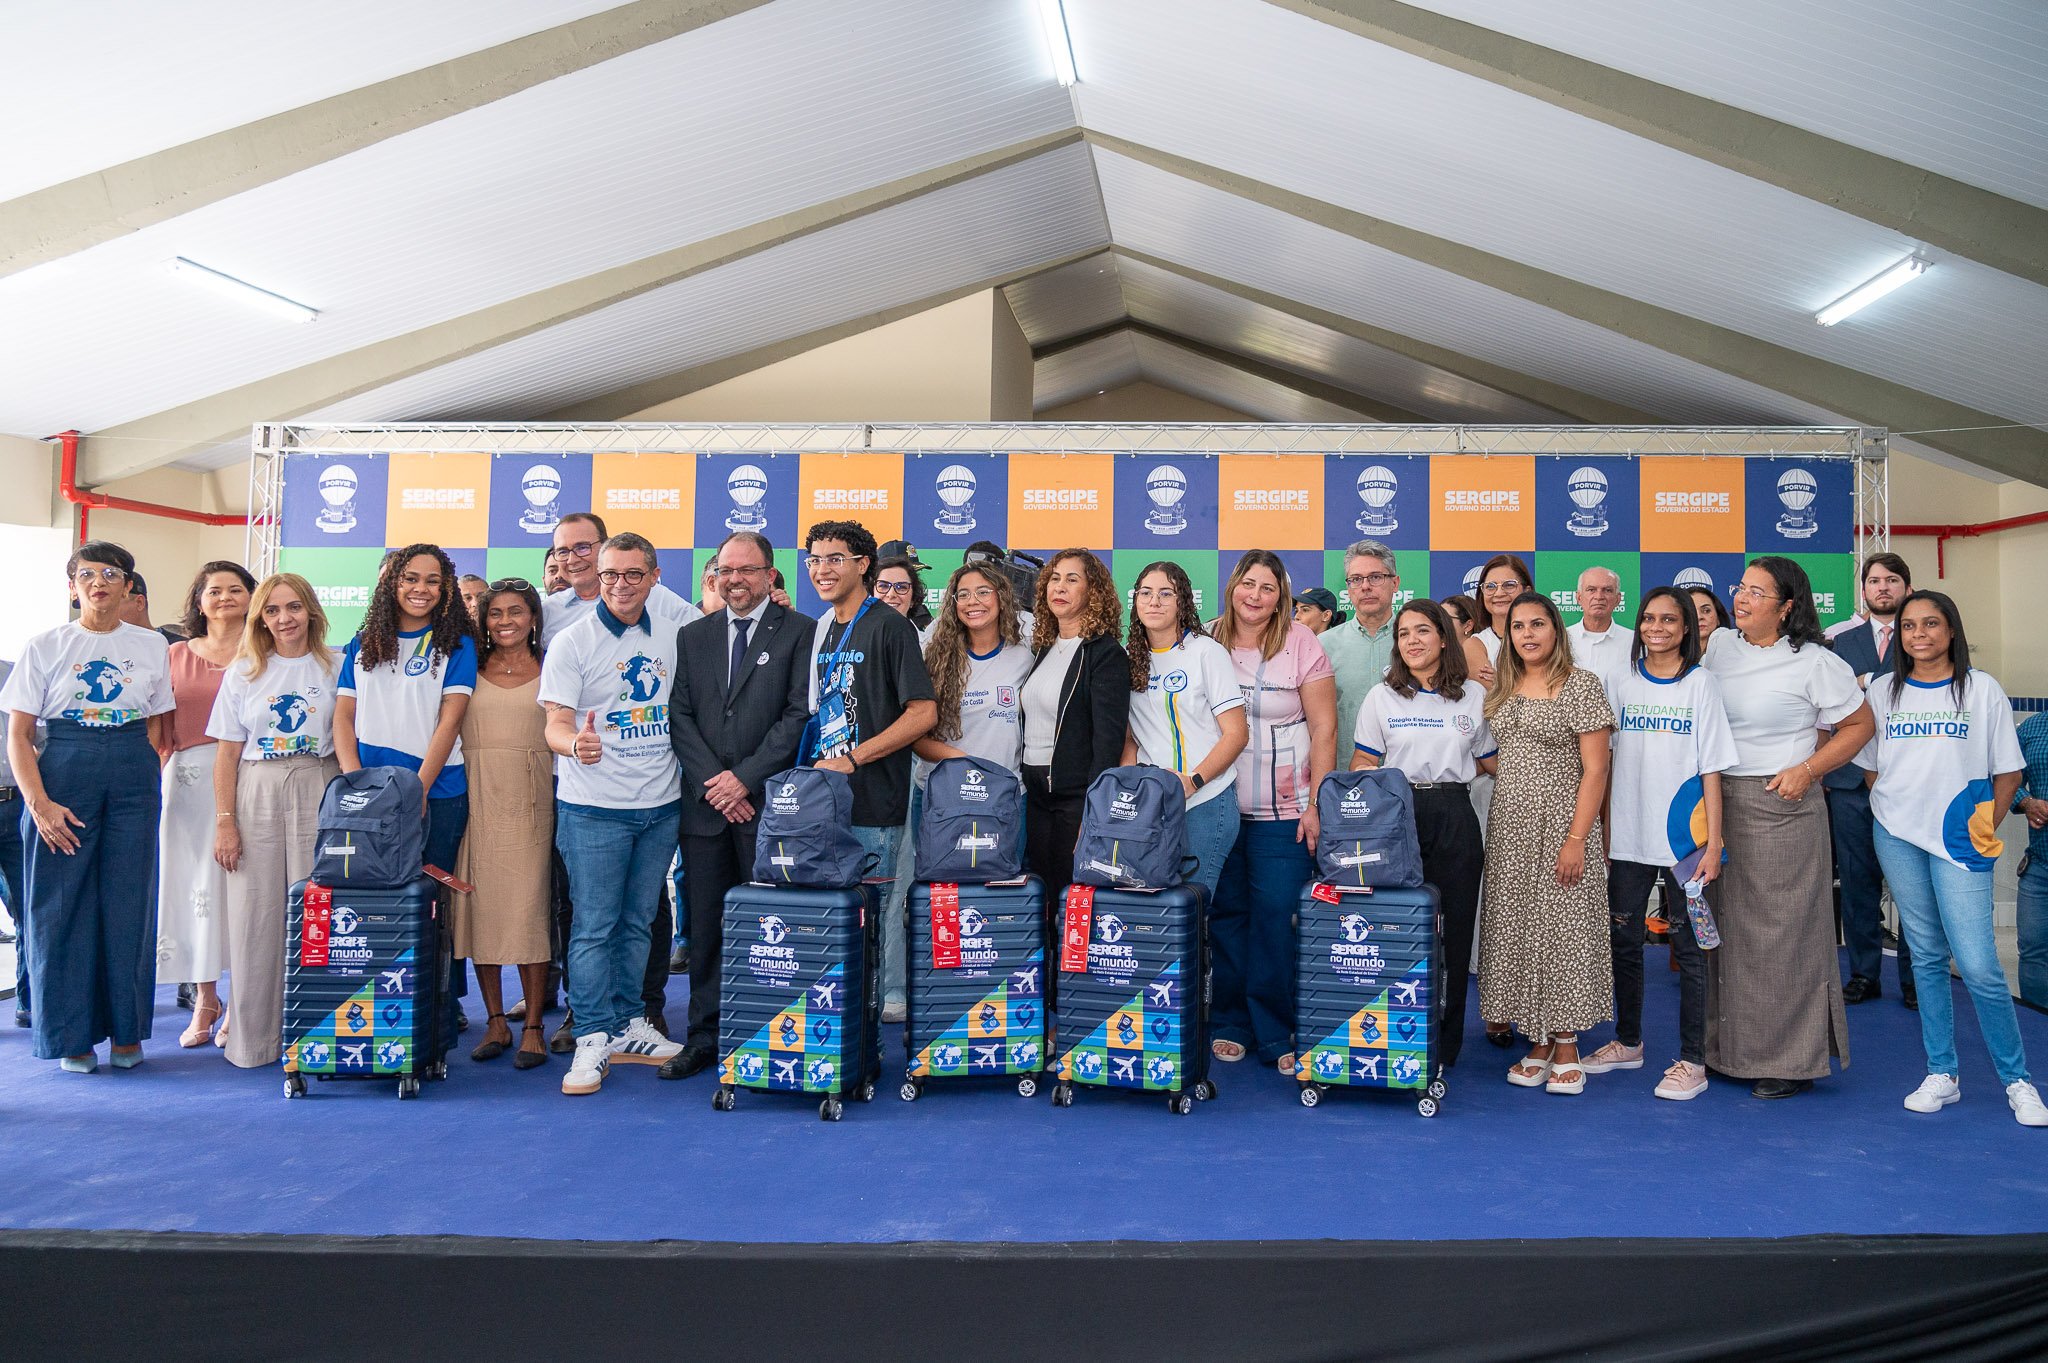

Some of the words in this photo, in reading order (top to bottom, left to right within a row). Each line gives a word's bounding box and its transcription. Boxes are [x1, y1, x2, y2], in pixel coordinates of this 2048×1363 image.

[326, 480, 351, 488] PORVIR
[402, 489, 475, 502] SERGIPE
[606, 489, 680, 502] SERGIPE
[814, 490, 888, 503] SERGIPE
[1024, 490, 1098, 503] SERGIPE
[1234, 490, 1309, 503] SERGIPE
[1445, 491, 1519, 504] SERGIPE
[1655, 492, 1729, 506] SERGIPE
[312, 586, 369, 600] ERGIPE
[606, 704, 669, 727] SERGIP
[1626, 704, 1693, 718] ESTUDANTE
[1890, 711, 1970, 722] ESTUDANTE
[1624, 716, 1692, 732] MONITOR
[1890, 722, 1969, 736] MONITOR
[328, 936, 367, 947] ERGIPE
[960, 938, 992, 948] RGIPE
[332, 948, 373, 958] mundo
[750, 945, 794, 958] SERGIPE
[960, 949, 998, 960] mundo
[1088, 944, 1132, 956] SERGIPE
[1331, 944, 1379, 956] SERGIPE
[761, 959, 800, 970] mundo
[1100, 957, 1138, 969] mundo
[1343, 957, 1385, 968] mundo
